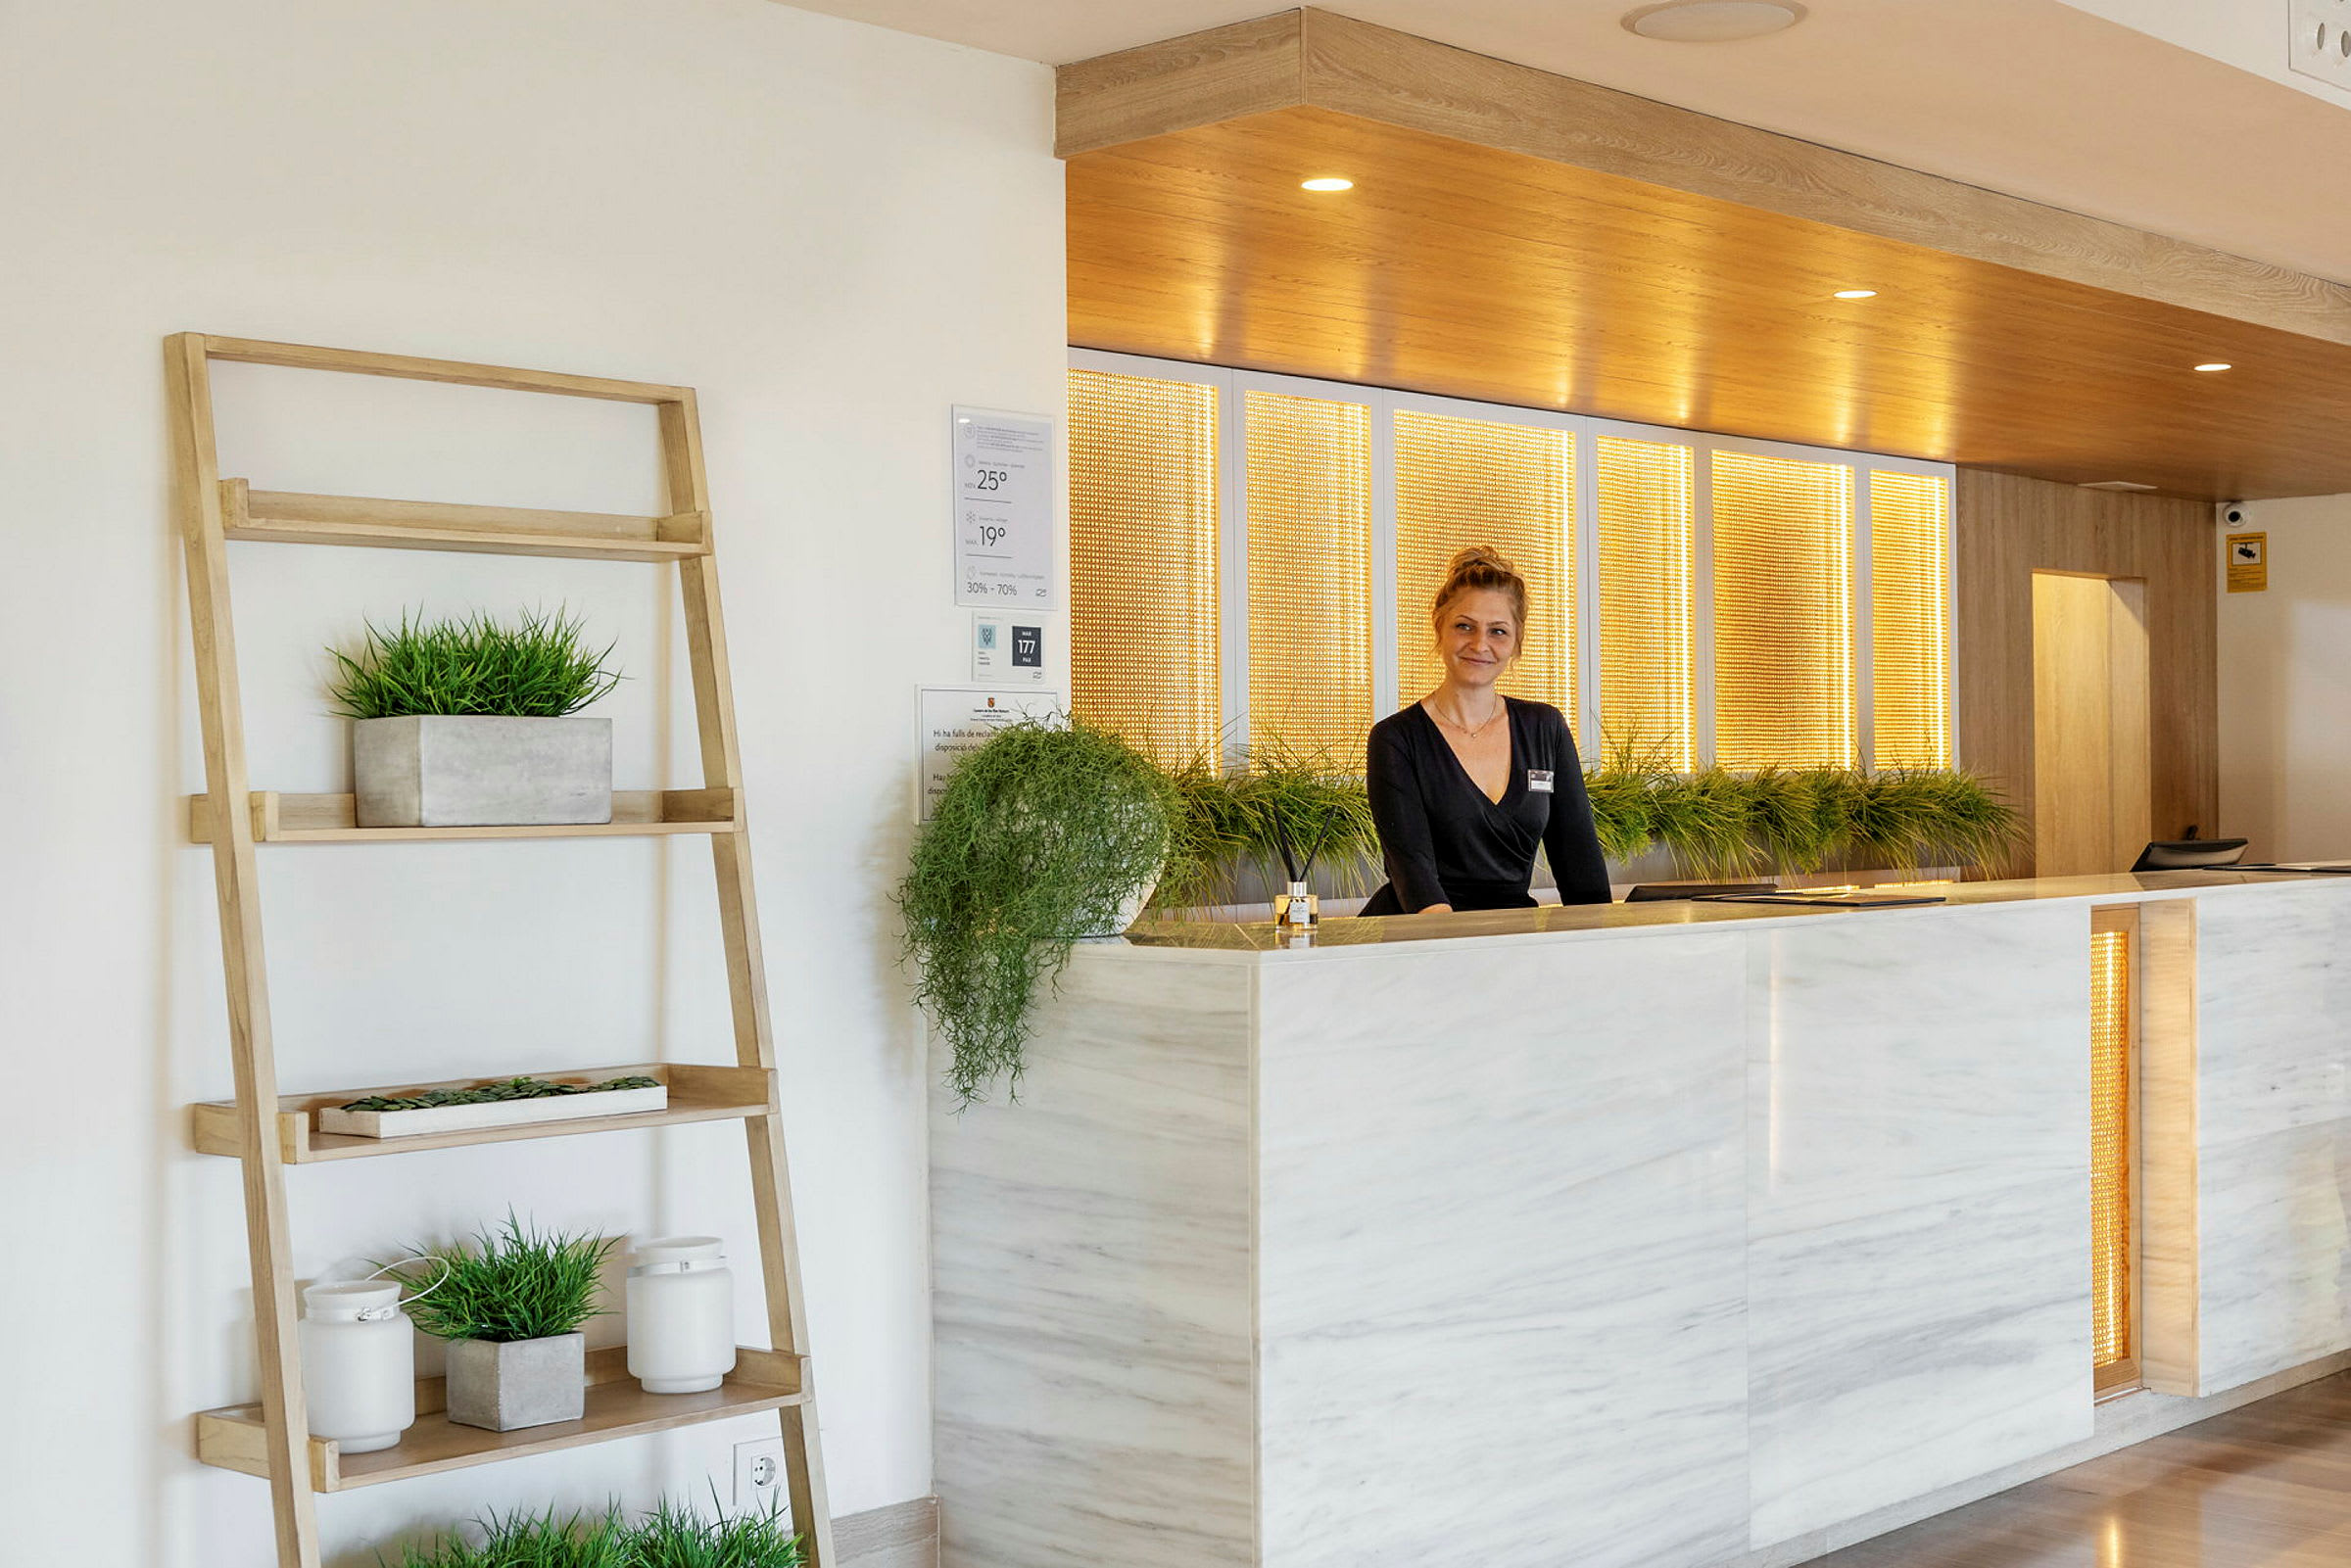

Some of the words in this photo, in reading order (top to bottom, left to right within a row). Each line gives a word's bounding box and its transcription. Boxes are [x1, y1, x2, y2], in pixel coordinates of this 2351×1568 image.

[967, 582, 988, 594] 30%
[997, 584, 1018, 595] 70%
[1018, 640, 1035, 654] 177
